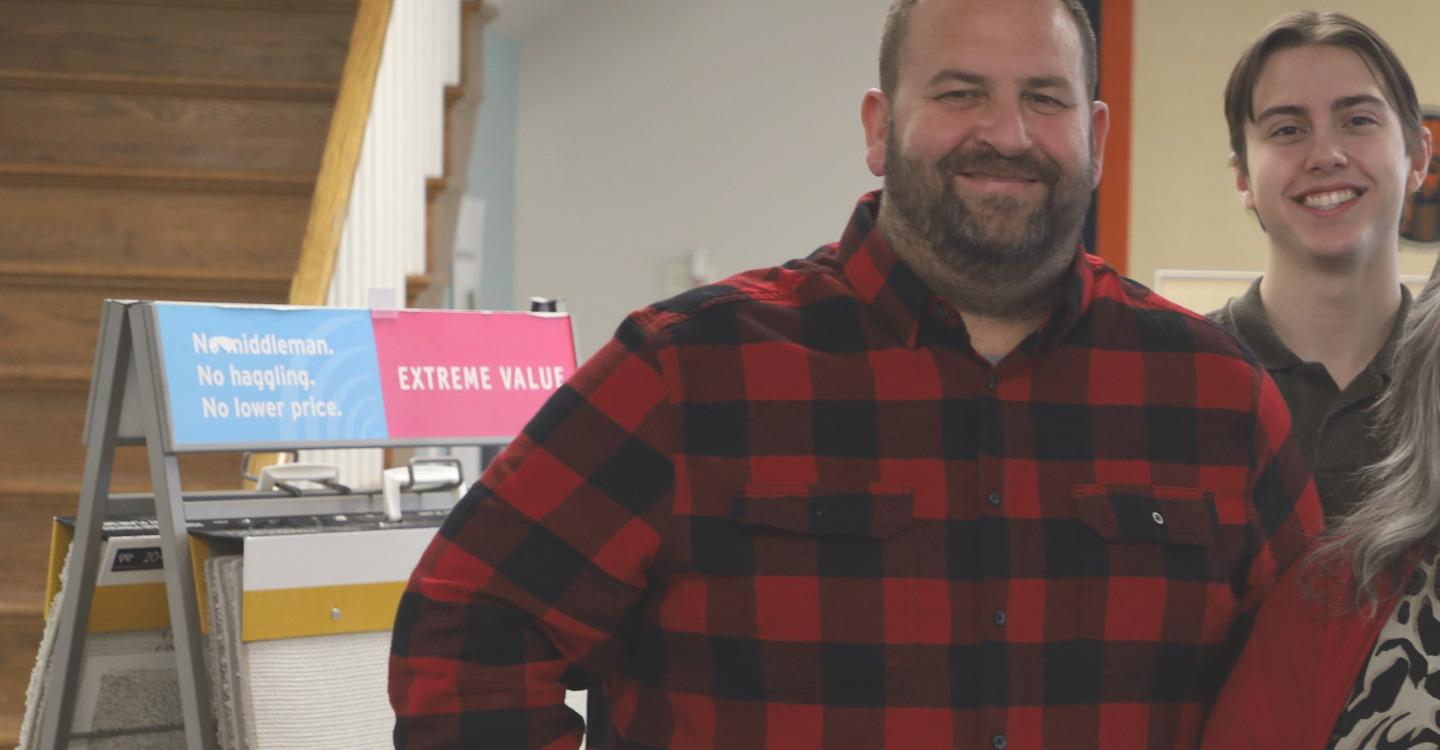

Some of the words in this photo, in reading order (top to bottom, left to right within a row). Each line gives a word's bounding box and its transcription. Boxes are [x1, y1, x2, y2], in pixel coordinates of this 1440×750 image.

[197, 364, 225, 386] No
[229, 363, 315, 391] haggling.
[397, 366, 493, 390] EXTREME
[499, 366, 564, 390] VALUE
[202, 396, 229, 418] No
[234, 397, 285, 418] lower
[291, 396, 343, 422] price.
